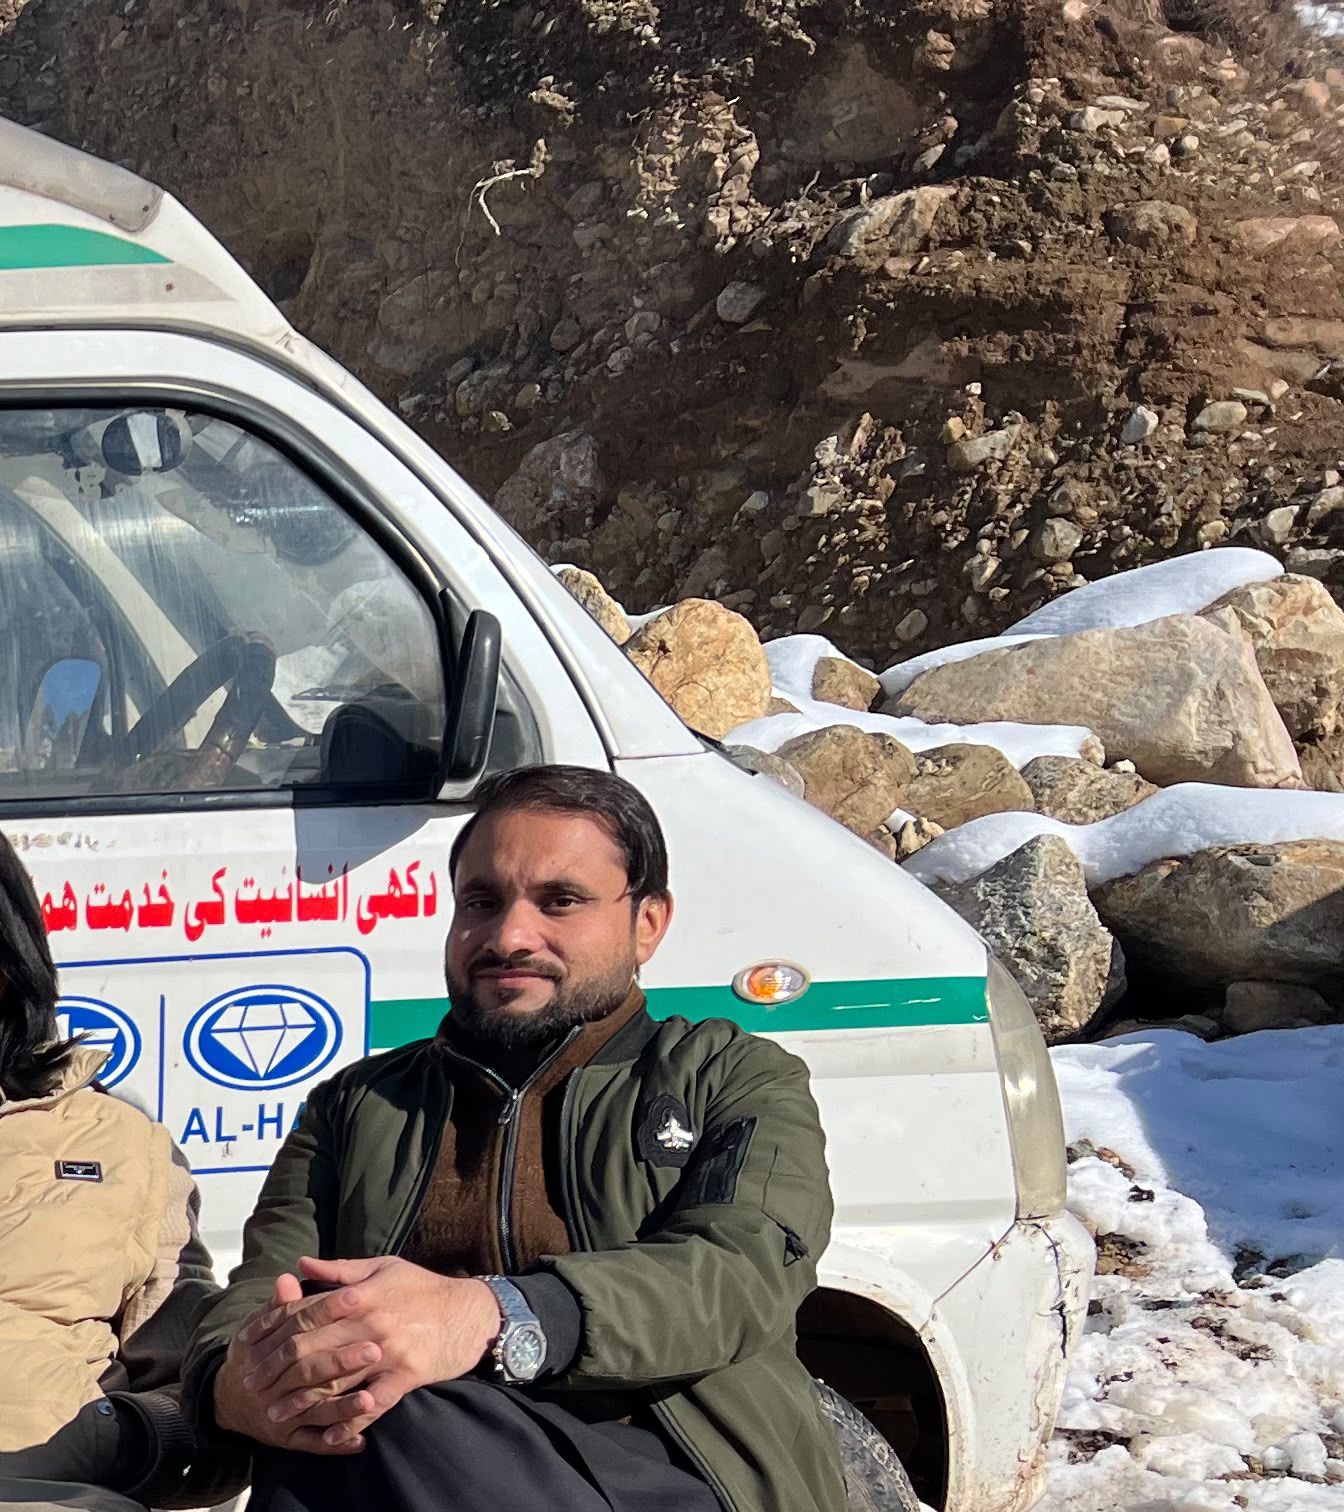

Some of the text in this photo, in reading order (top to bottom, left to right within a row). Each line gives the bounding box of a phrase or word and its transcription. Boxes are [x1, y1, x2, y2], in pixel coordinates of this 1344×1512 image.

[85, 869, 175, 933] خدمت
[184, 866, 227, 942] کی
[234, 861, 349, 940] انسانیت
